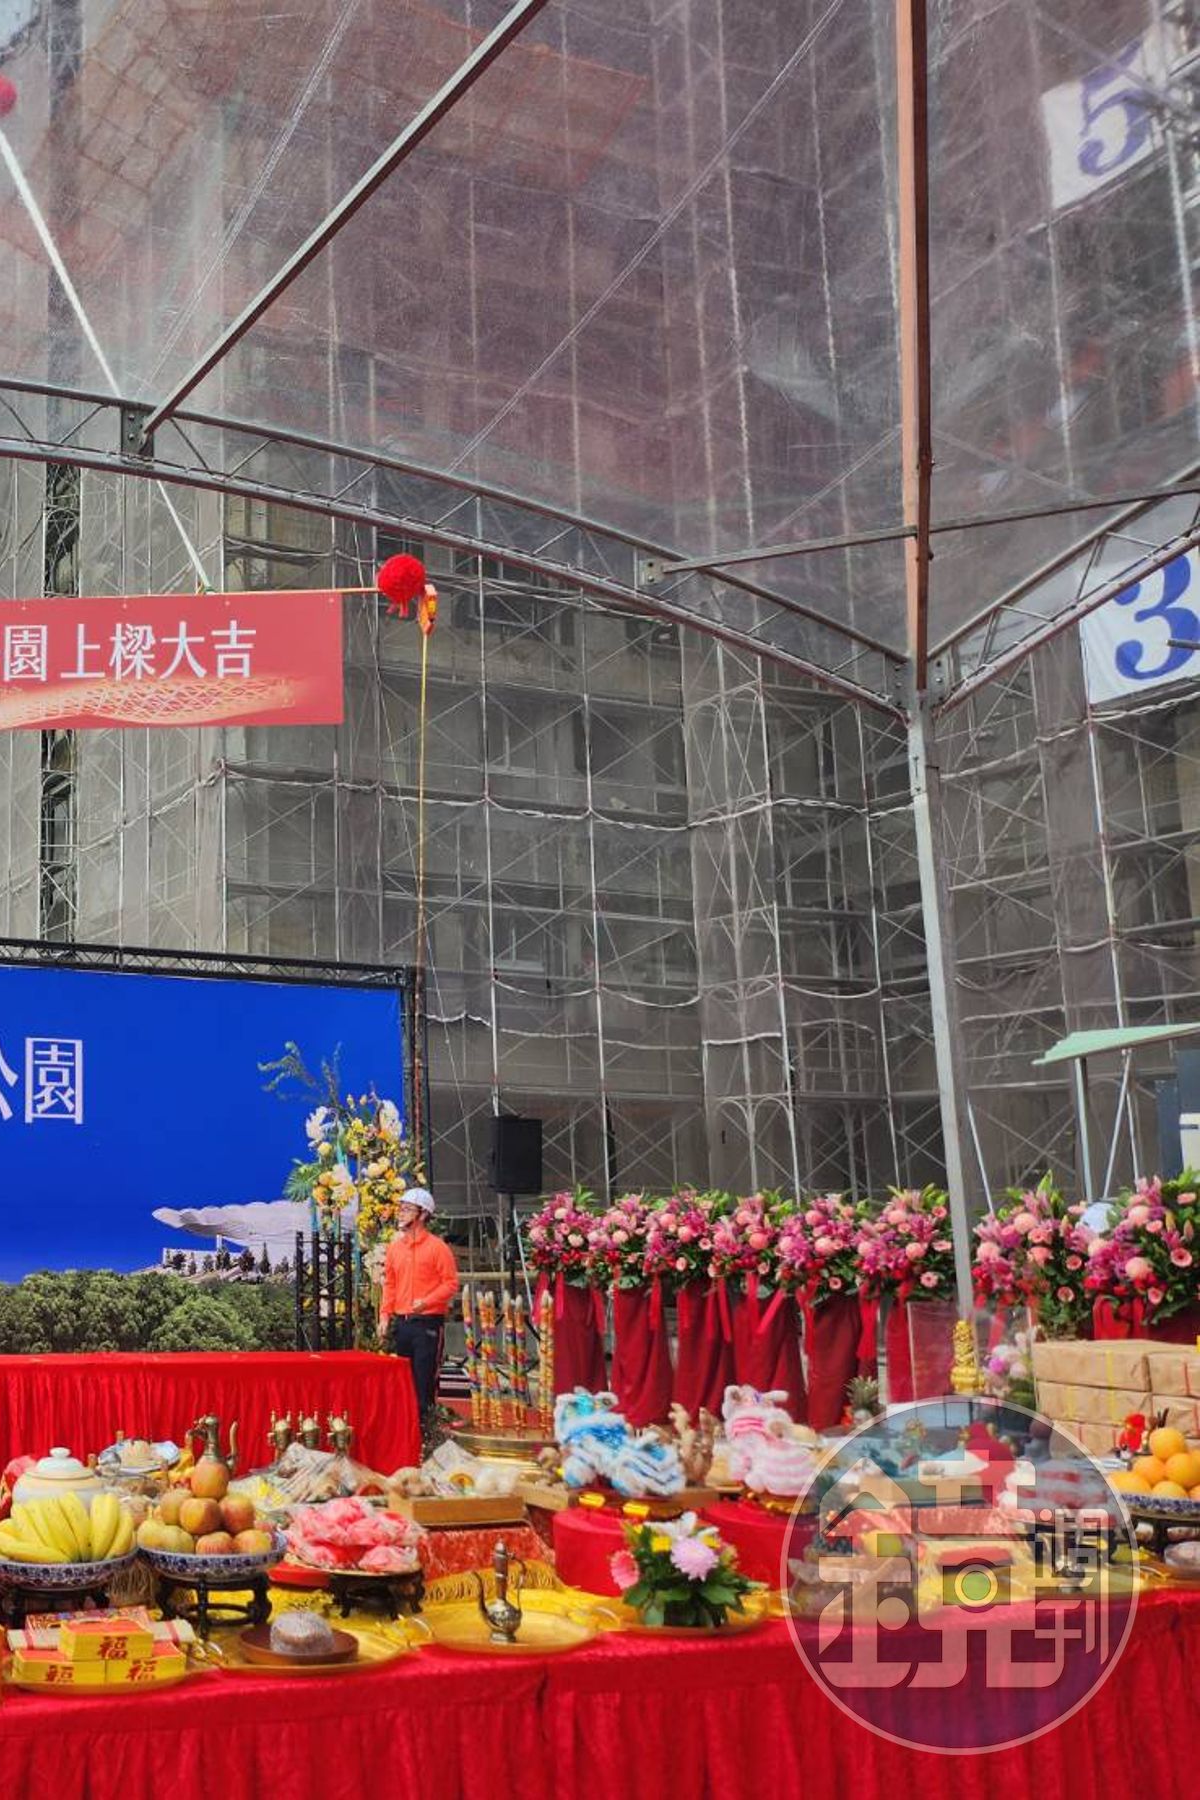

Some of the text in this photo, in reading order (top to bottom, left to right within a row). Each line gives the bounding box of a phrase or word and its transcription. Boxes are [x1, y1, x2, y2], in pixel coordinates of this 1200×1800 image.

[1077, 37, 1151, 177] 5
[1112, 553, 1200, 681] 3
[98, 1636, 129, 1660] 福
